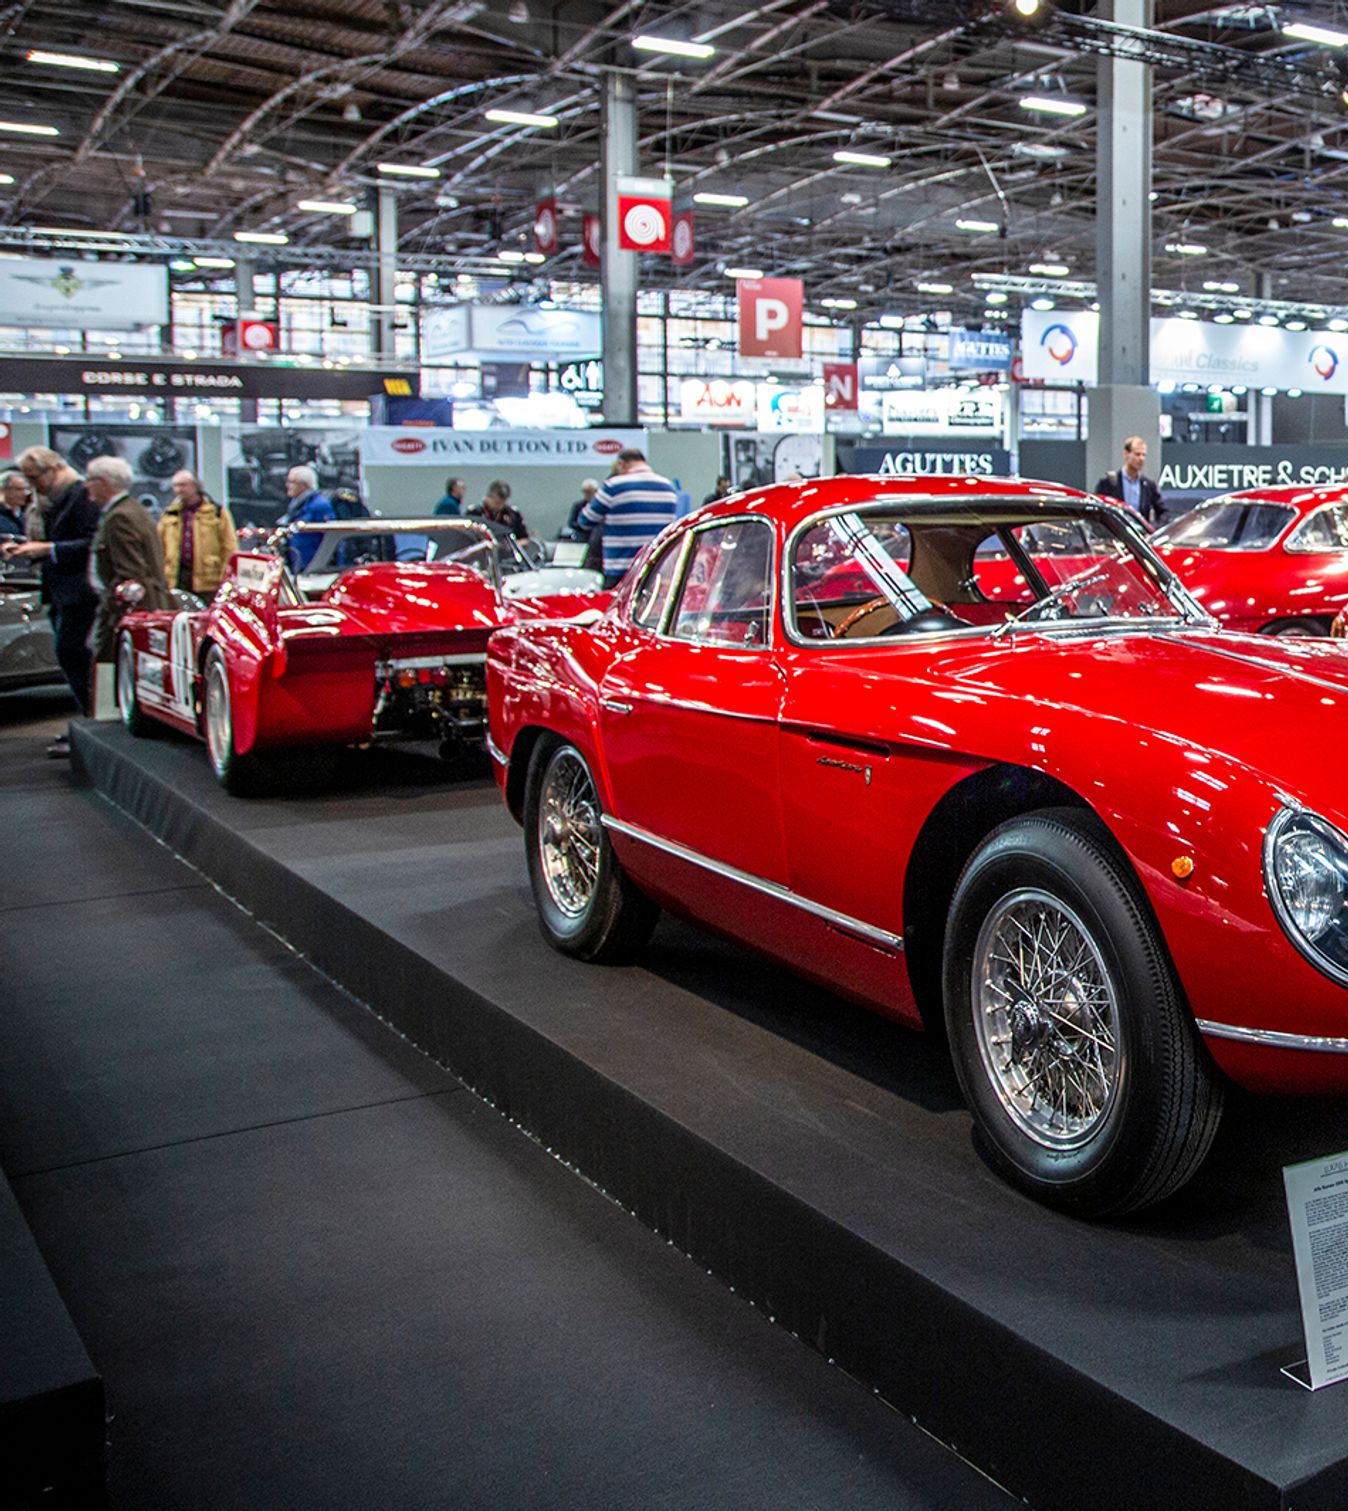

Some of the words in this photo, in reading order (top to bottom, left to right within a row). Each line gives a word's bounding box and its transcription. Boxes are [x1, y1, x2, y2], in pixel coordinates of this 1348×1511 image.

[755, 297, 789, 341] P
[82, 371, 148, 386] CORSE
[152, 372, 167, 386] E
[171, 373, 243, 388] STRADA
[830, 374, 852, 401] N
[432, 439, 475, 454] IVAN
[480, 439, 551, 454] DUTTON
[556, 440, 588, 454] LTD
[878, 452, 993, 474] AGUTTES
[1159, 464, 1272, 488] AUXIETRE
[1277, 460, 1296, 484] &
